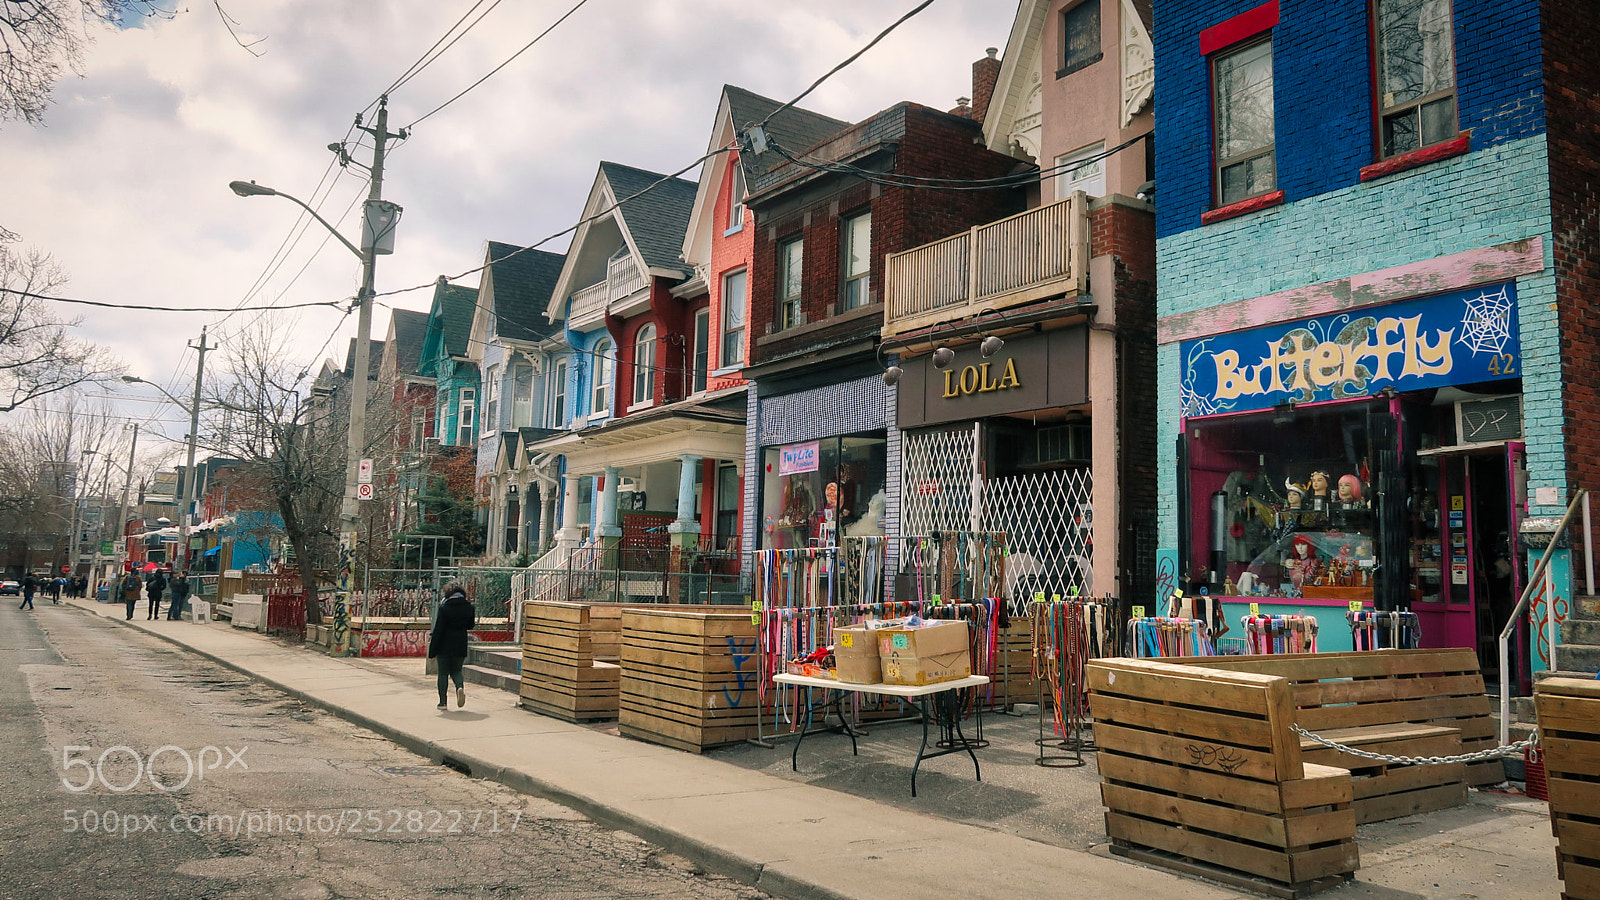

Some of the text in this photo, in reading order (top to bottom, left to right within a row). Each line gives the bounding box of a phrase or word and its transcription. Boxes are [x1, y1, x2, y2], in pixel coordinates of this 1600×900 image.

[1210, 313, 1456, 401] Butterfly
[1487, 353, 1515, 377] 42
[942, 357, 1021, 399] LOLA
[1462, 408, 1508, 438] DP
